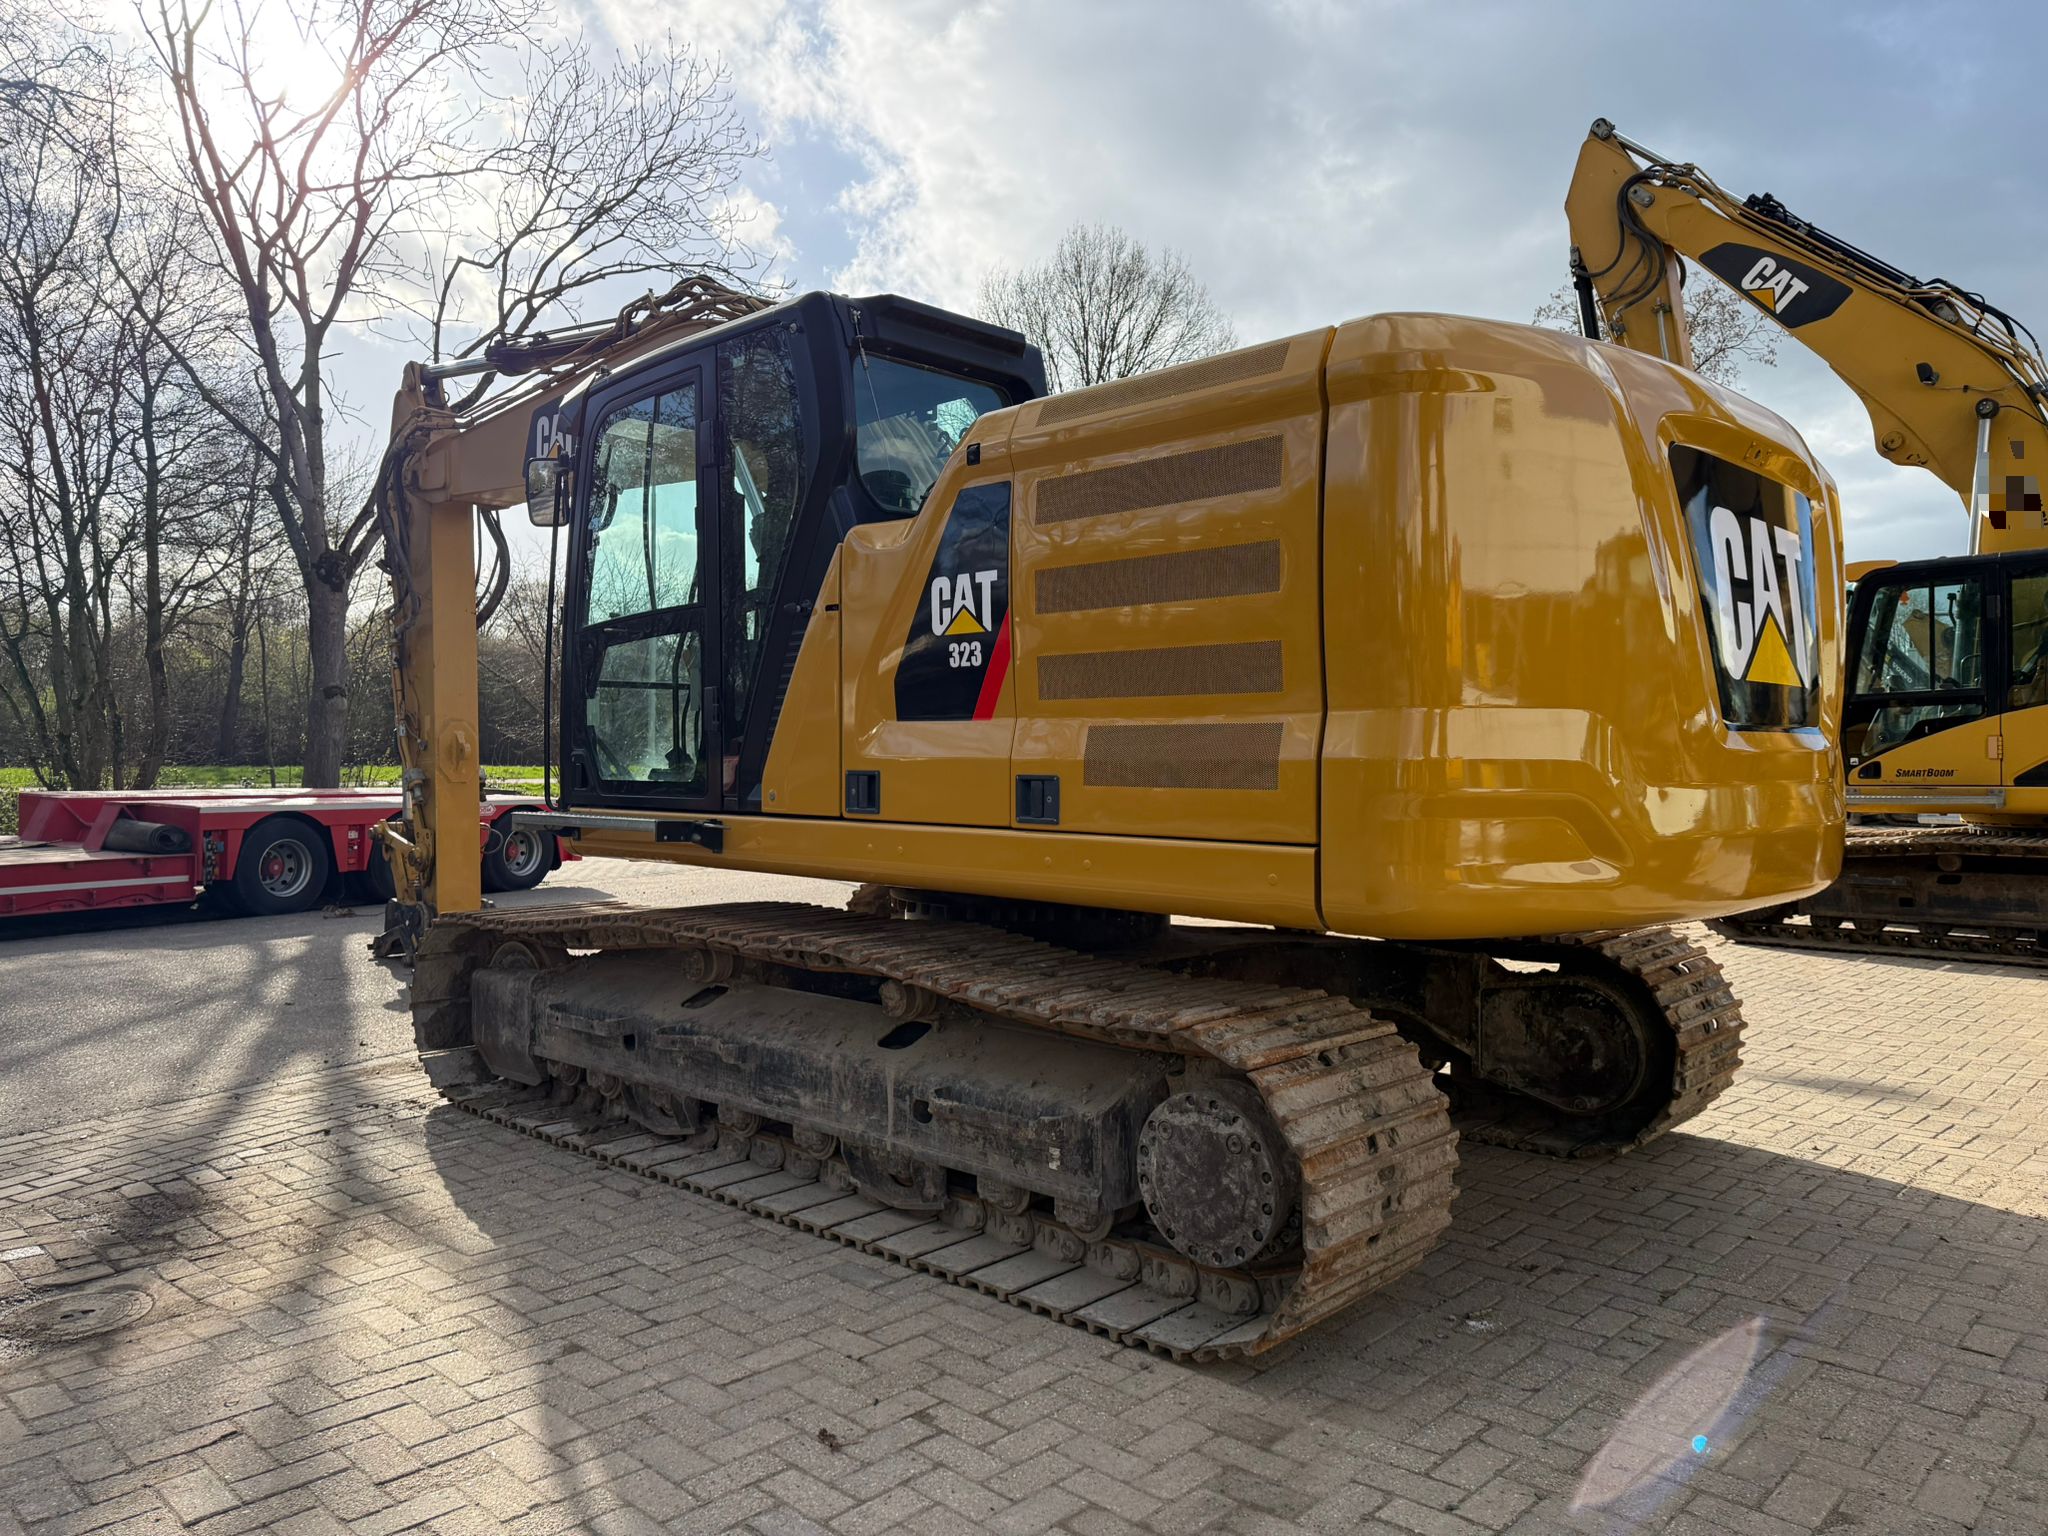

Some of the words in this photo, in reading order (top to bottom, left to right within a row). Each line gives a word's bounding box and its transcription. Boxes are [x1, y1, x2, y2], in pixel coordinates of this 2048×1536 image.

[1741, 256, 1810, 314] CAT
[931, 569, 998, 636] CAT
[1709, 506, 1810, 689] CAT
[948, 641, 982, 668] 323
